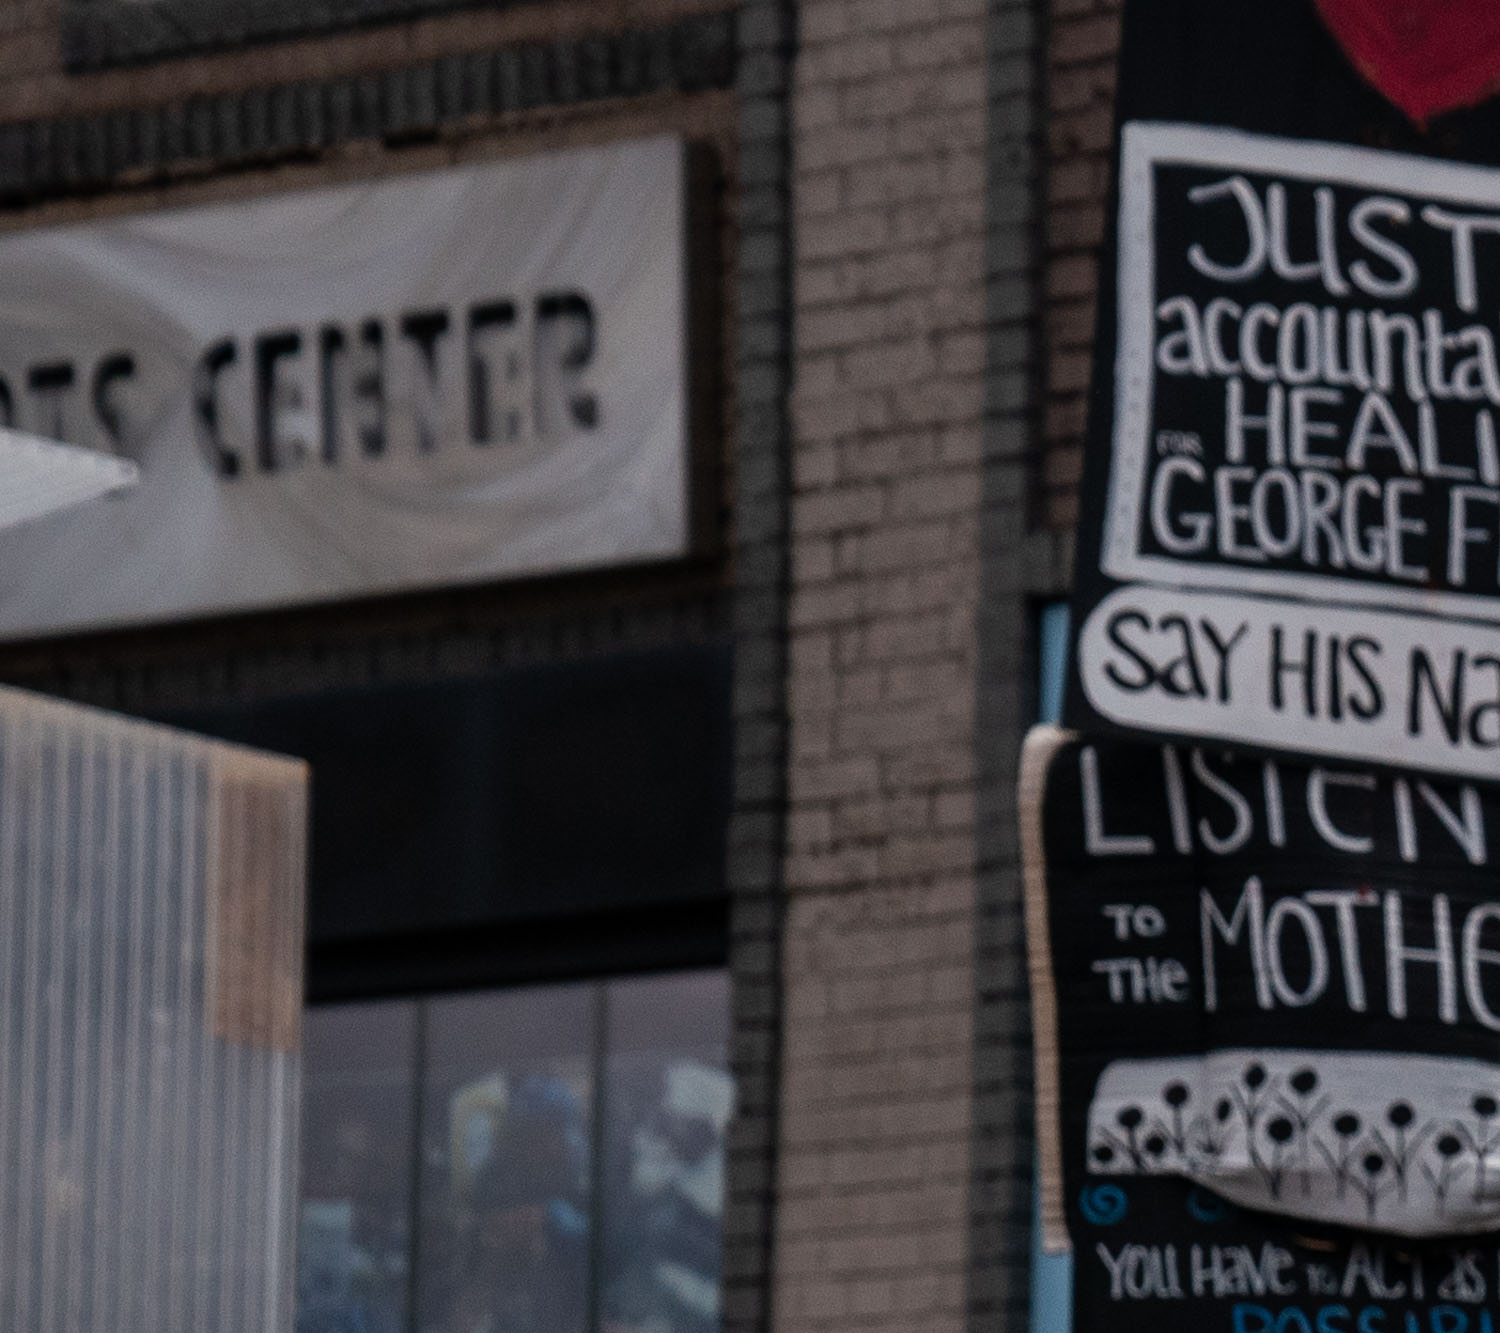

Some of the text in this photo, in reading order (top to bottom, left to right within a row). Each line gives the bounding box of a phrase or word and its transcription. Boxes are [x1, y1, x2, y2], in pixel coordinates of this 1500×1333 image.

[192, 287, 602, 482] CENTER
[1150, 454, 1430, 582] GEORGE
[1270, 622, 1385, 723] HIS
[1102, 904, 1167, 939] TO
[1096, 1242, 1179, 1300] YOU
